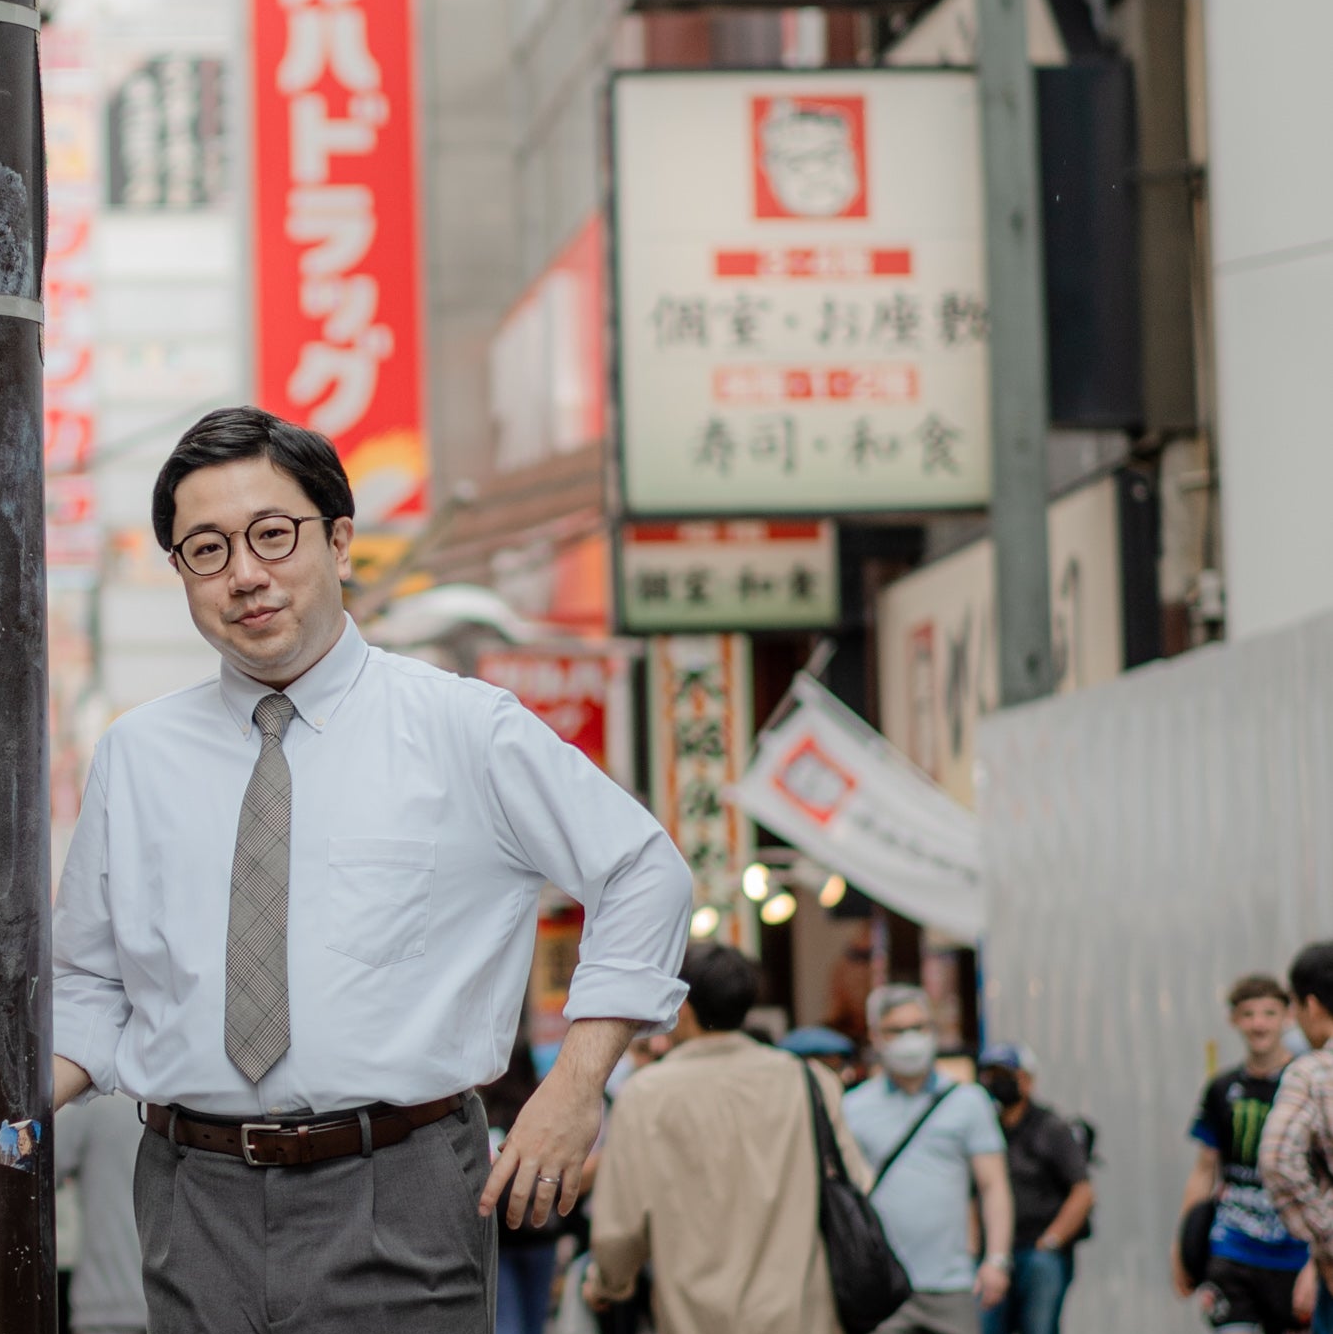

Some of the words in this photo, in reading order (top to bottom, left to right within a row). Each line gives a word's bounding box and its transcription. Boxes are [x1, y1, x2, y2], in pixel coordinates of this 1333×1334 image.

[694, 415, 960, 476] 寿司・和食
